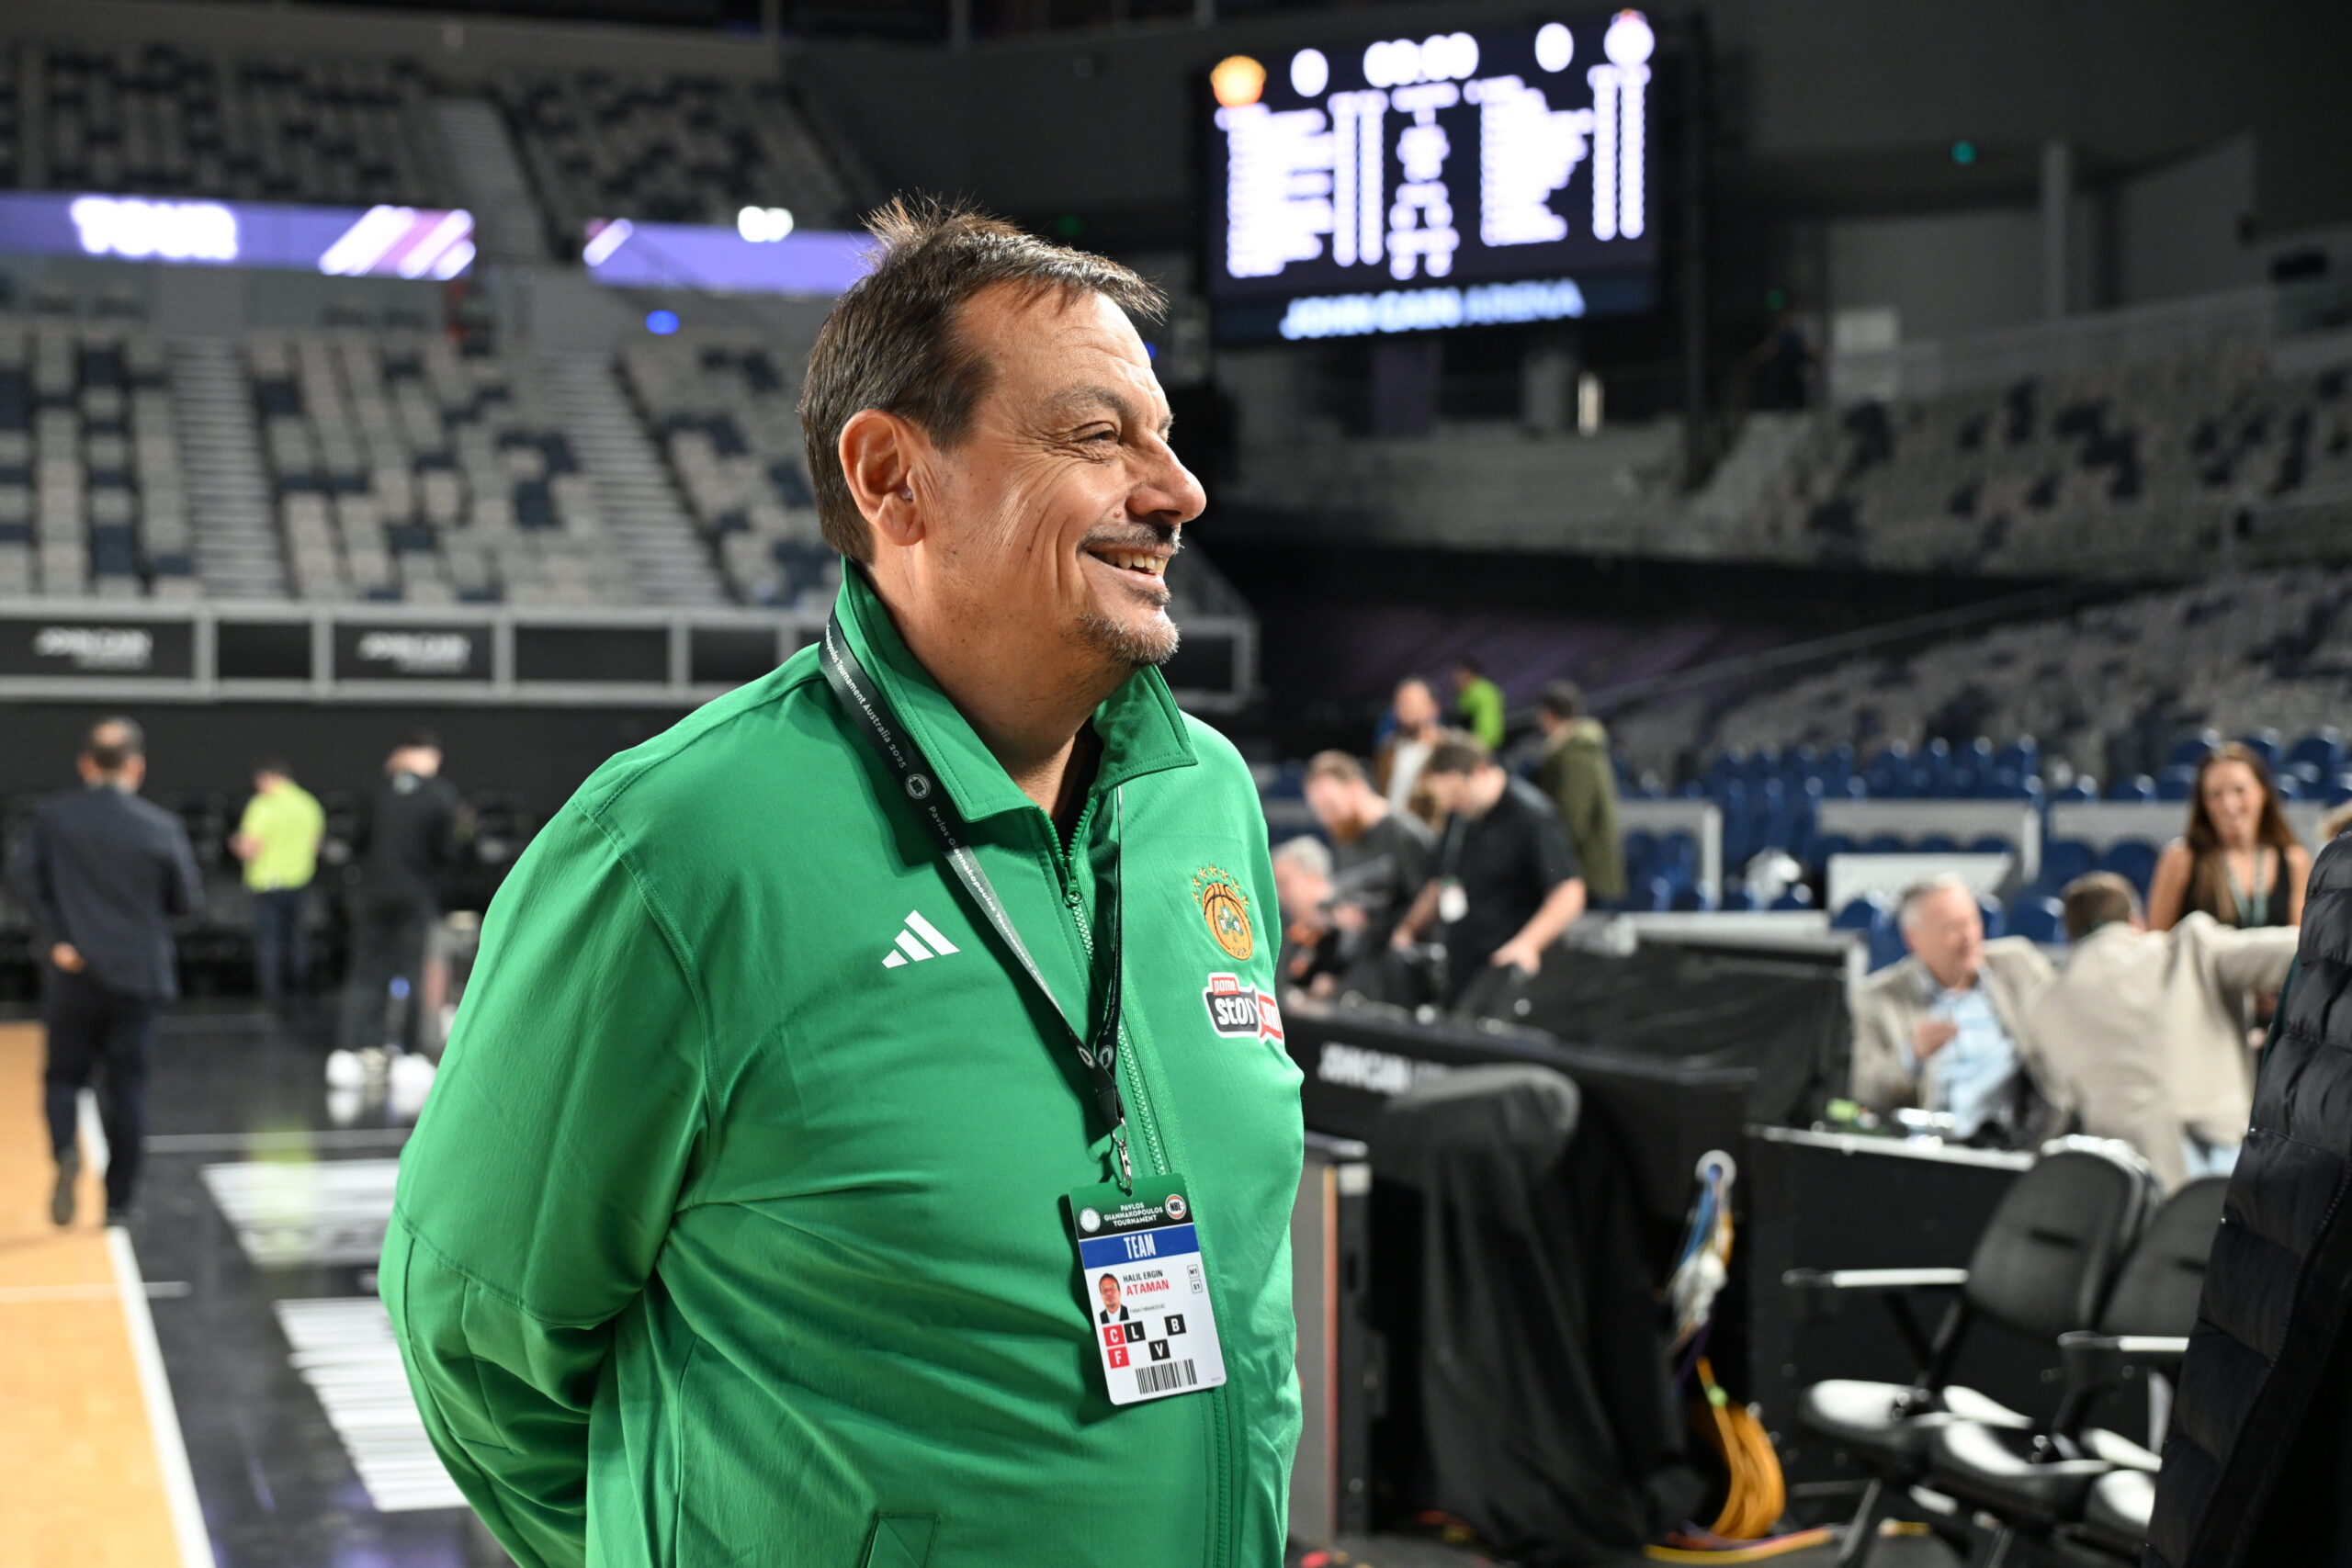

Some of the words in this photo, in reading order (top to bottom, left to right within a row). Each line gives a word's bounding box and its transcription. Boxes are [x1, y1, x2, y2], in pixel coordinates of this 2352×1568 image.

[836, 660, 866, 705] Tournament
[863, 704, 891, 743] Australia
[889, 744, 907, 769] 2025
[928, 806, 950, 837] Pavlos
[1103, 1207, 1163, 1221] GIANNAKOPOULOS
[1120, 1201, 1145, 1212] PAVLOS
[1114, 1214, 1157, 1226] TOURNAMENT
[1124, 1234, 1156, 1259] TEAM
[1123, 1273, 1142, 1283] HALIL
[1143, 1269, 1163, 1279] ERGIN
[1126, 1279, 1170, 1296] ATAMAN
[1110, 1328, 1119, 1343] C
[1130, 1325, 1139, 1339] L
[1170, 1318, 1180, 1333] B
[1114, 1349, 1122, 1365] F
[1154, 1342, 1164, 1358] V
